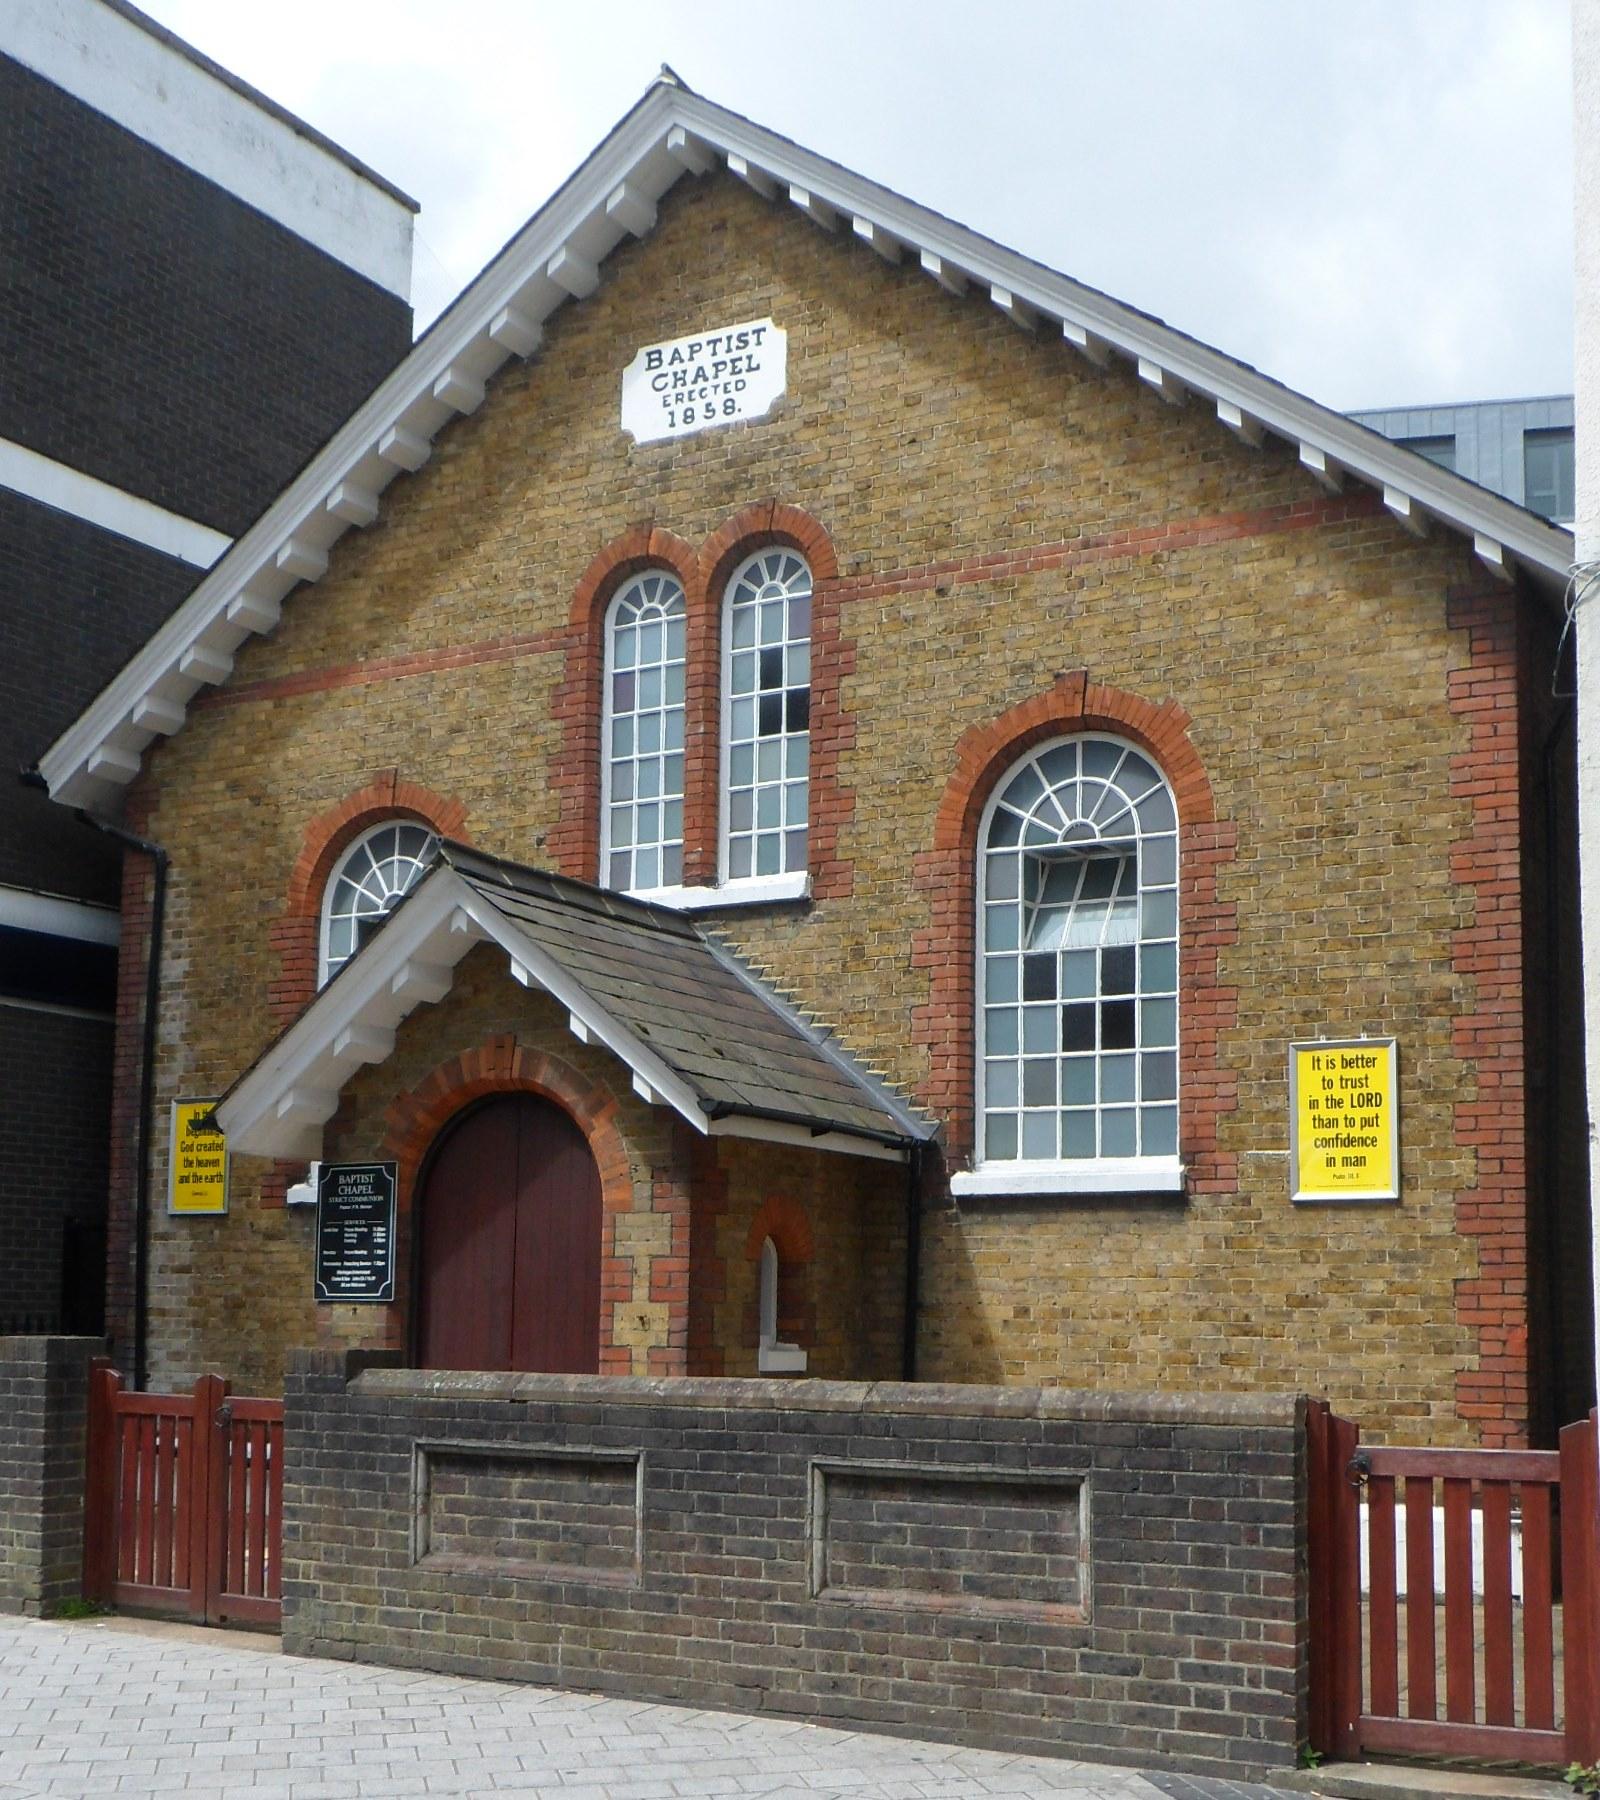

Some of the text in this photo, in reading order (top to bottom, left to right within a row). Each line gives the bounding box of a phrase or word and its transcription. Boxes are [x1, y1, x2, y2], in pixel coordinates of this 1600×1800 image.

[645, 327, 767, 371] BAPTIST
[651, 354, 760, 392] CHAPEL
[662, 379, 746, 408] ERECTED
[668, 398, 742, 428] 1858.
[1312, 1054, 1378, 1071] It is better
[1322, 1074, 1369, 1090] to trust
[1309, 1092, 1382, 1110] in the LORD
[1312, 1113, 1380, 1131] than to put
[180, 1140, 224, 1153] God created
[1314, 1133, 1378, 1148] confidence
[183, 1156, 220, 1168] the heaven
[1326, 1153, 1366, 1167] in man
[178, 1171, 224, 1184] and the earth
[339, 1174, 375, 1184] BAPTIST
[338, 1185, 374, 1195] CHAPEL
